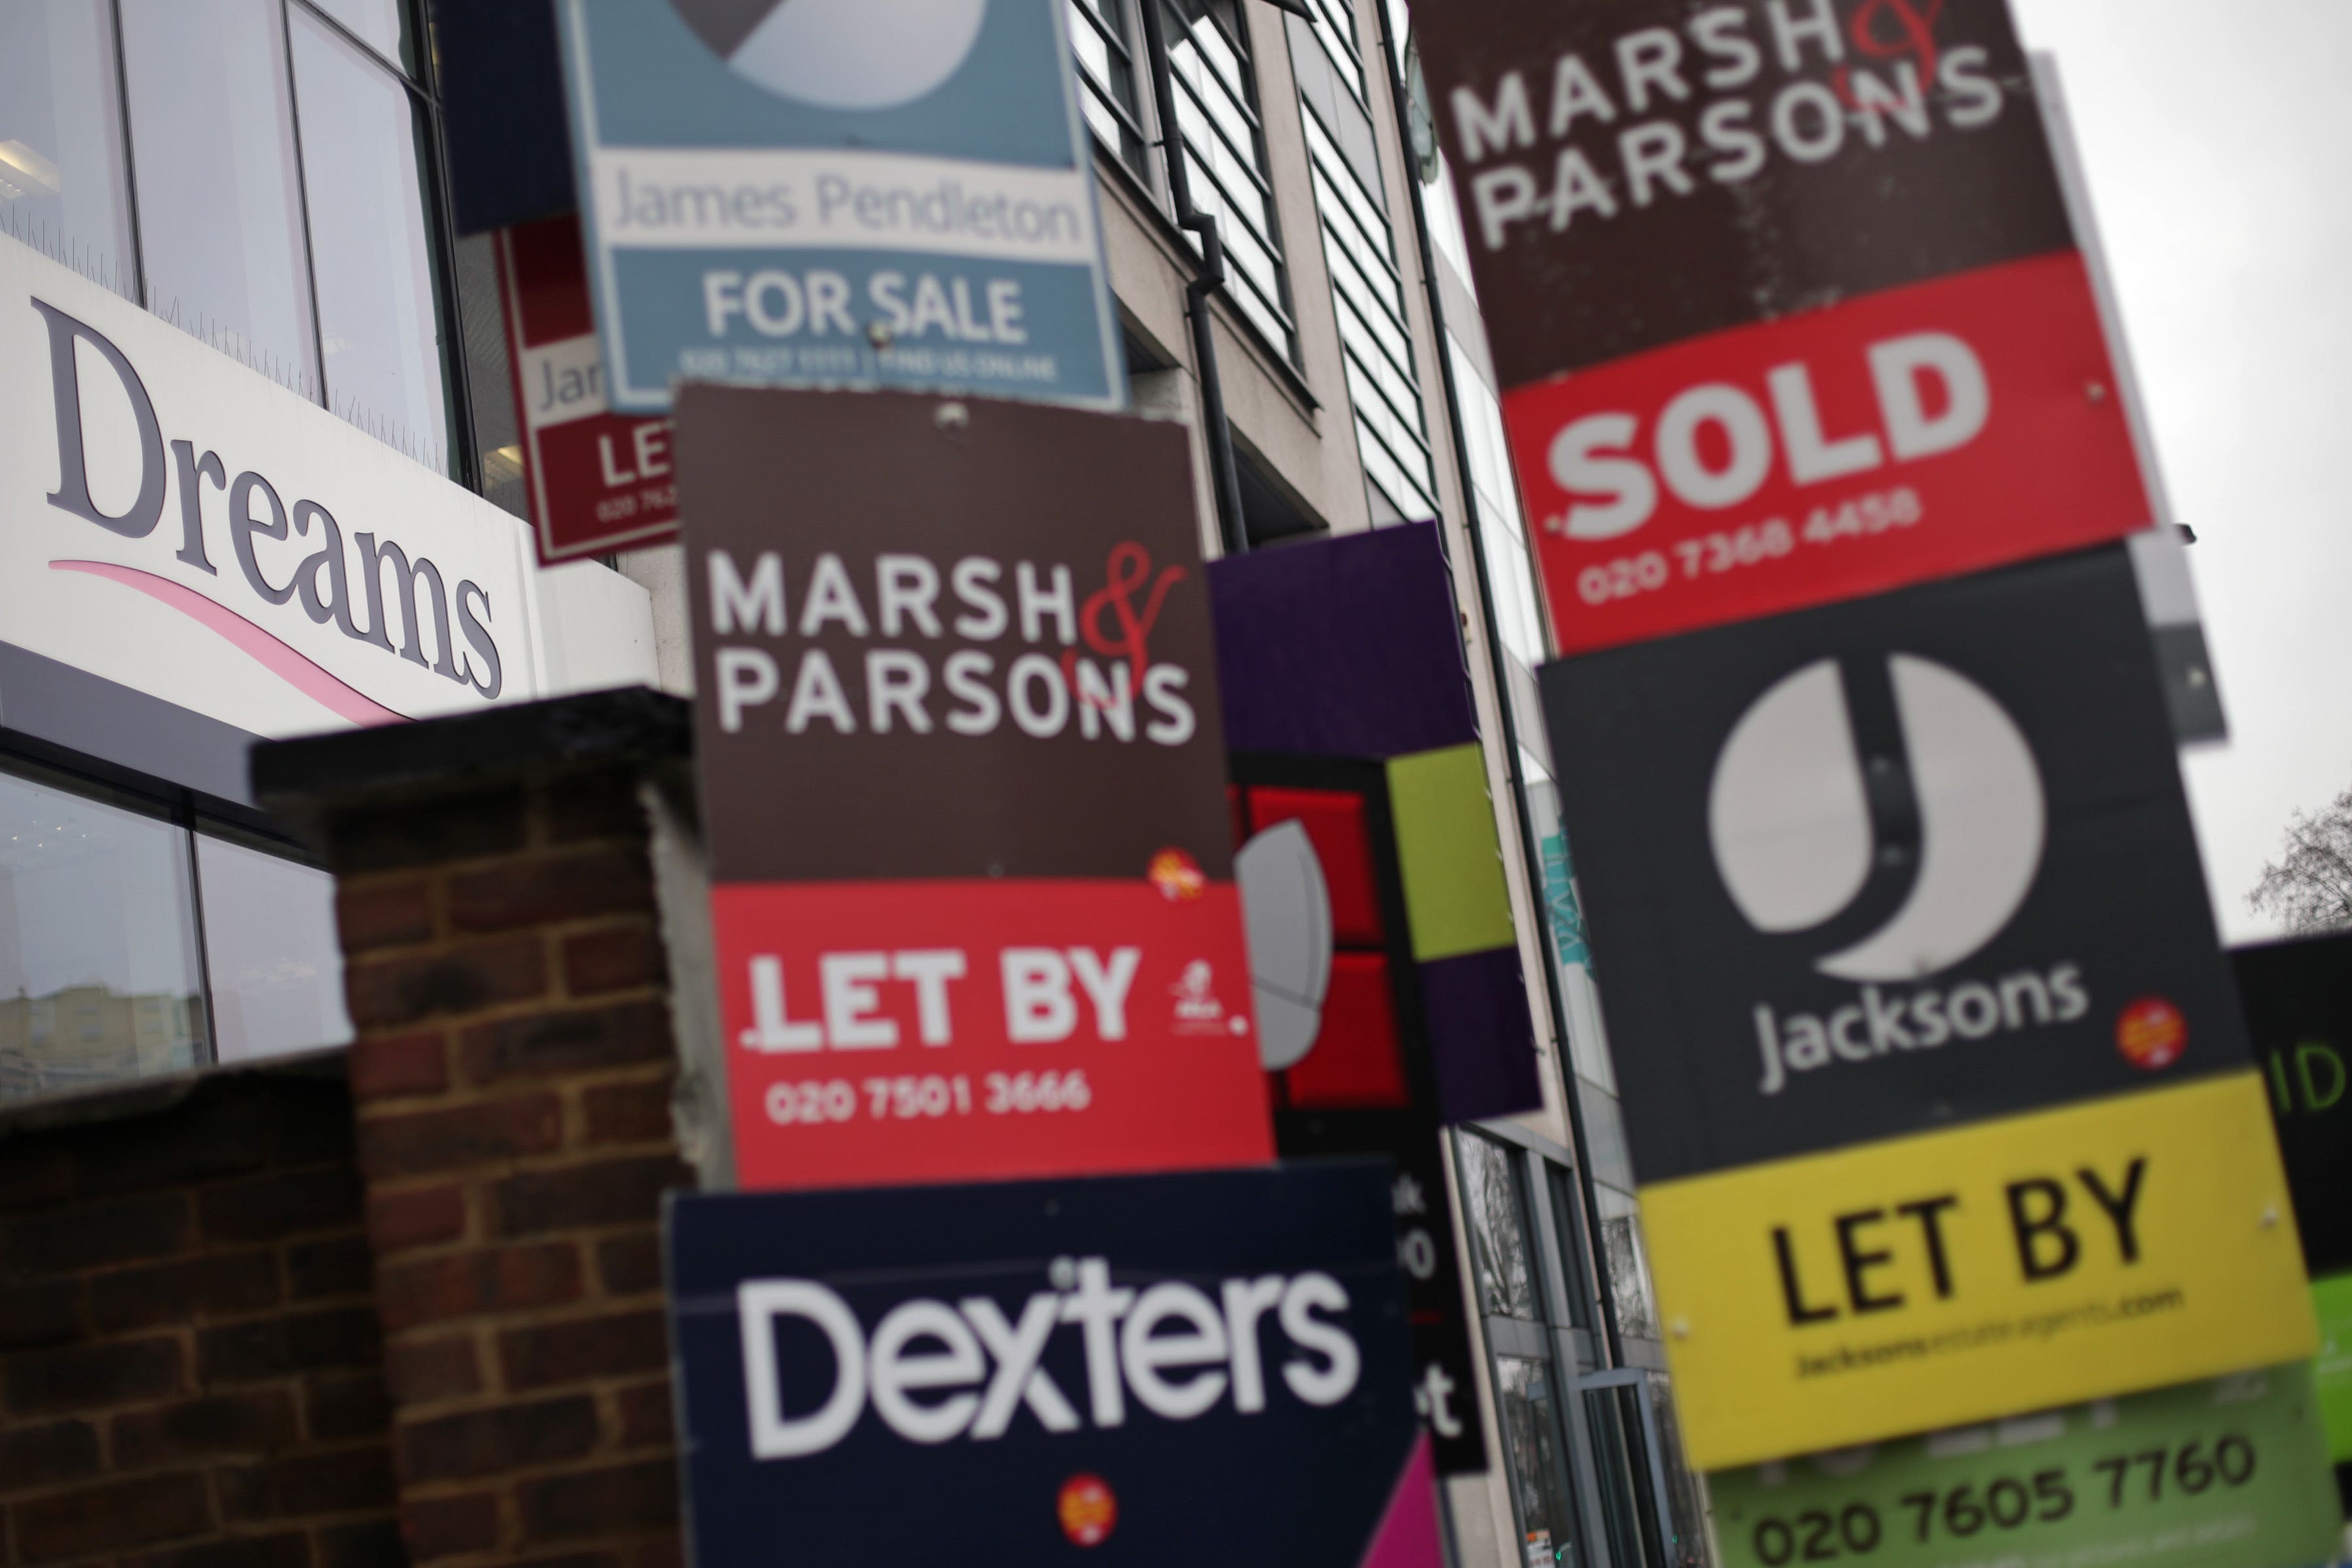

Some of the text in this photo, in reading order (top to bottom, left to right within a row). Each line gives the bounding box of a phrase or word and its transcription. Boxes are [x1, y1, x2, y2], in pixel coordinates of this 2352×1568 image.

[1450, 0, 1847, 162] MARSH
[612, 169, 1082, 244] James Pendleton
[1471, 46, 2003, 251] PARSONS
[702, 270, 1028, 344] FOR SALE
[598, 418, 676, 487] LE
[1546, 331, 1991, 541] SOLD
[29, 295, 502, 699] Dreams
[707, 548, 1078, 645] MARSH
[1577, 551, 1668, 605] 020
[715, 645, 1197, 746] PARSONS
[748, 945, 1142, 1053] LET BY
[1754, 962, 2089, 1096] Jacksons
[764, 1070, 1091, 1125] 020 7501 3666
[1771, 1154, 2149, 1328] LET BY
[737, 1256, 1361, 1460] Dexters
[1754, 1503, 1881, 1567] 020
[1900, 1468, 2075, 1543] 7605
[2094, 1434, 2257, 1509] 7760
